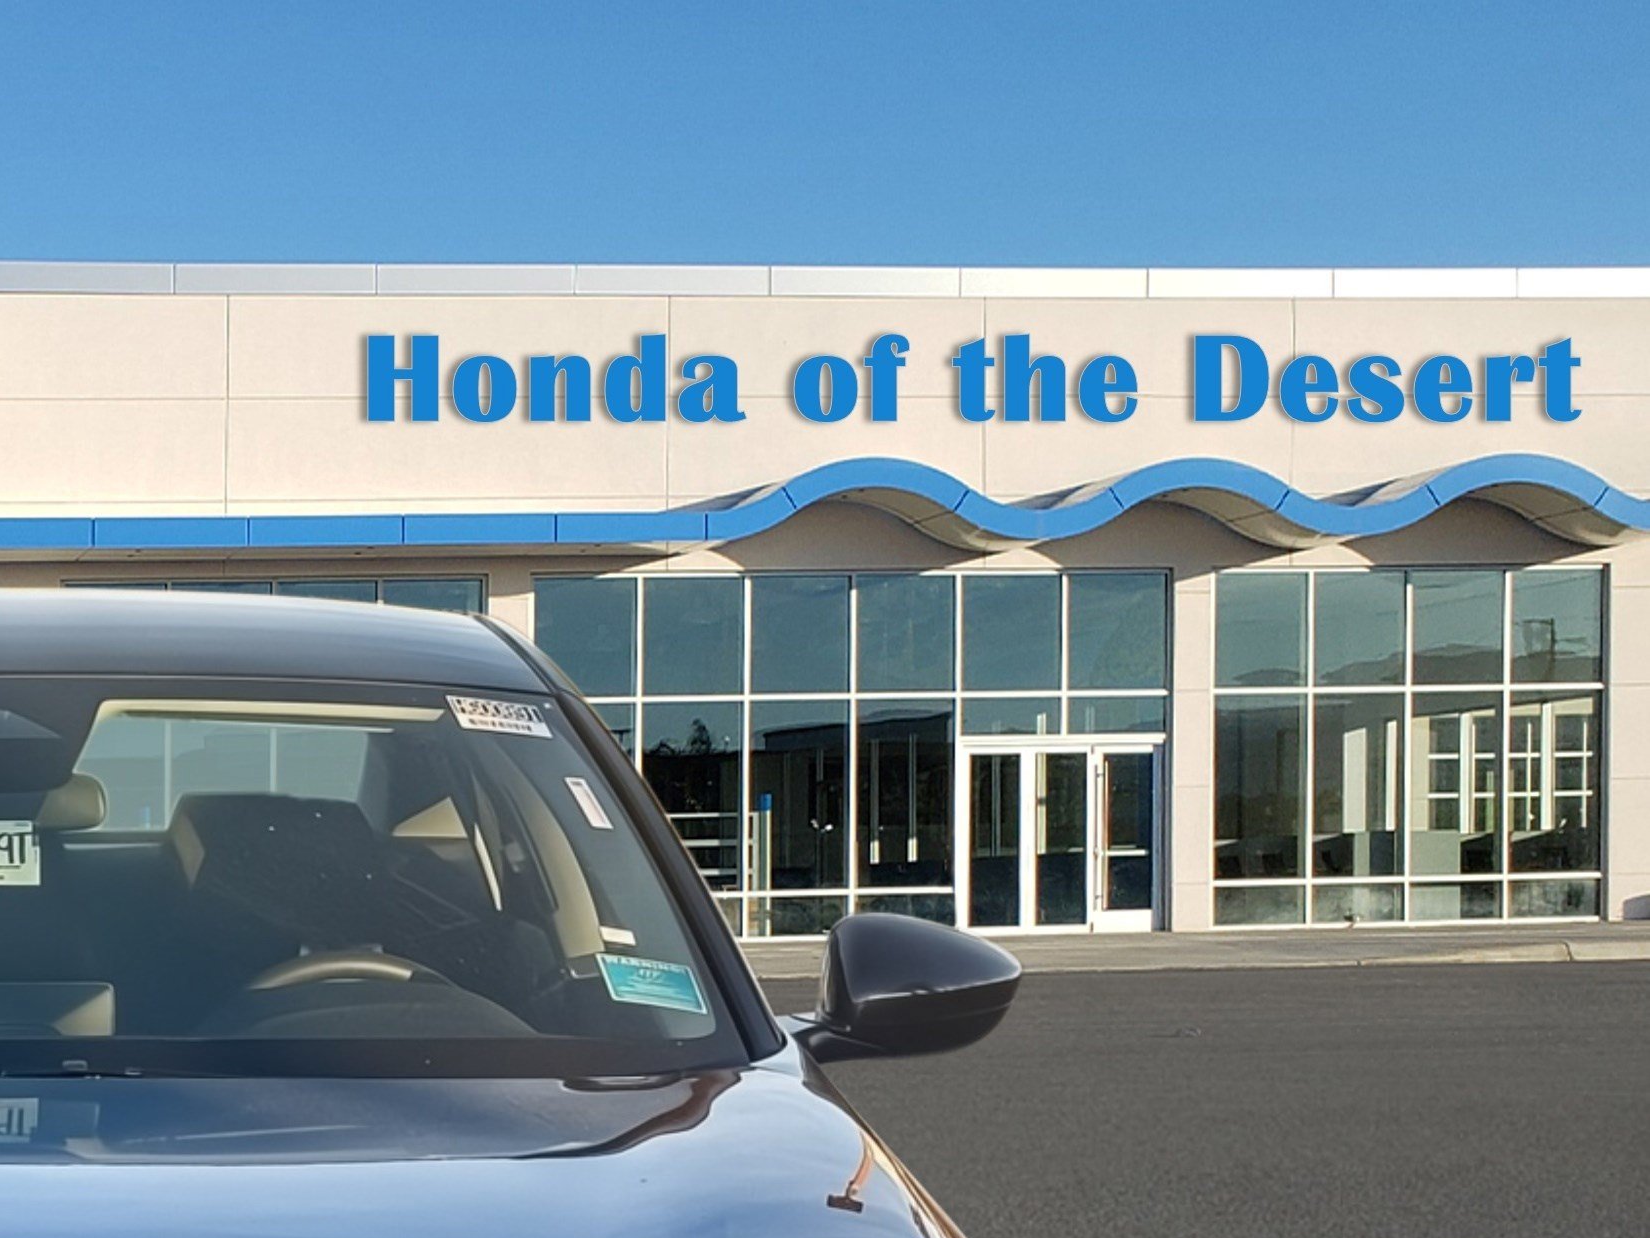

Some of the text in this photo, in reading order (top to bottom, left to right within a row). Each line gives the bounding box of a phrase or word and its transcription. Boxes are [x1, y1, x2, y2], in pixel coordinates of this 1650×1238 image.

[367, 333, 1583, 423] Honda of the Desert
